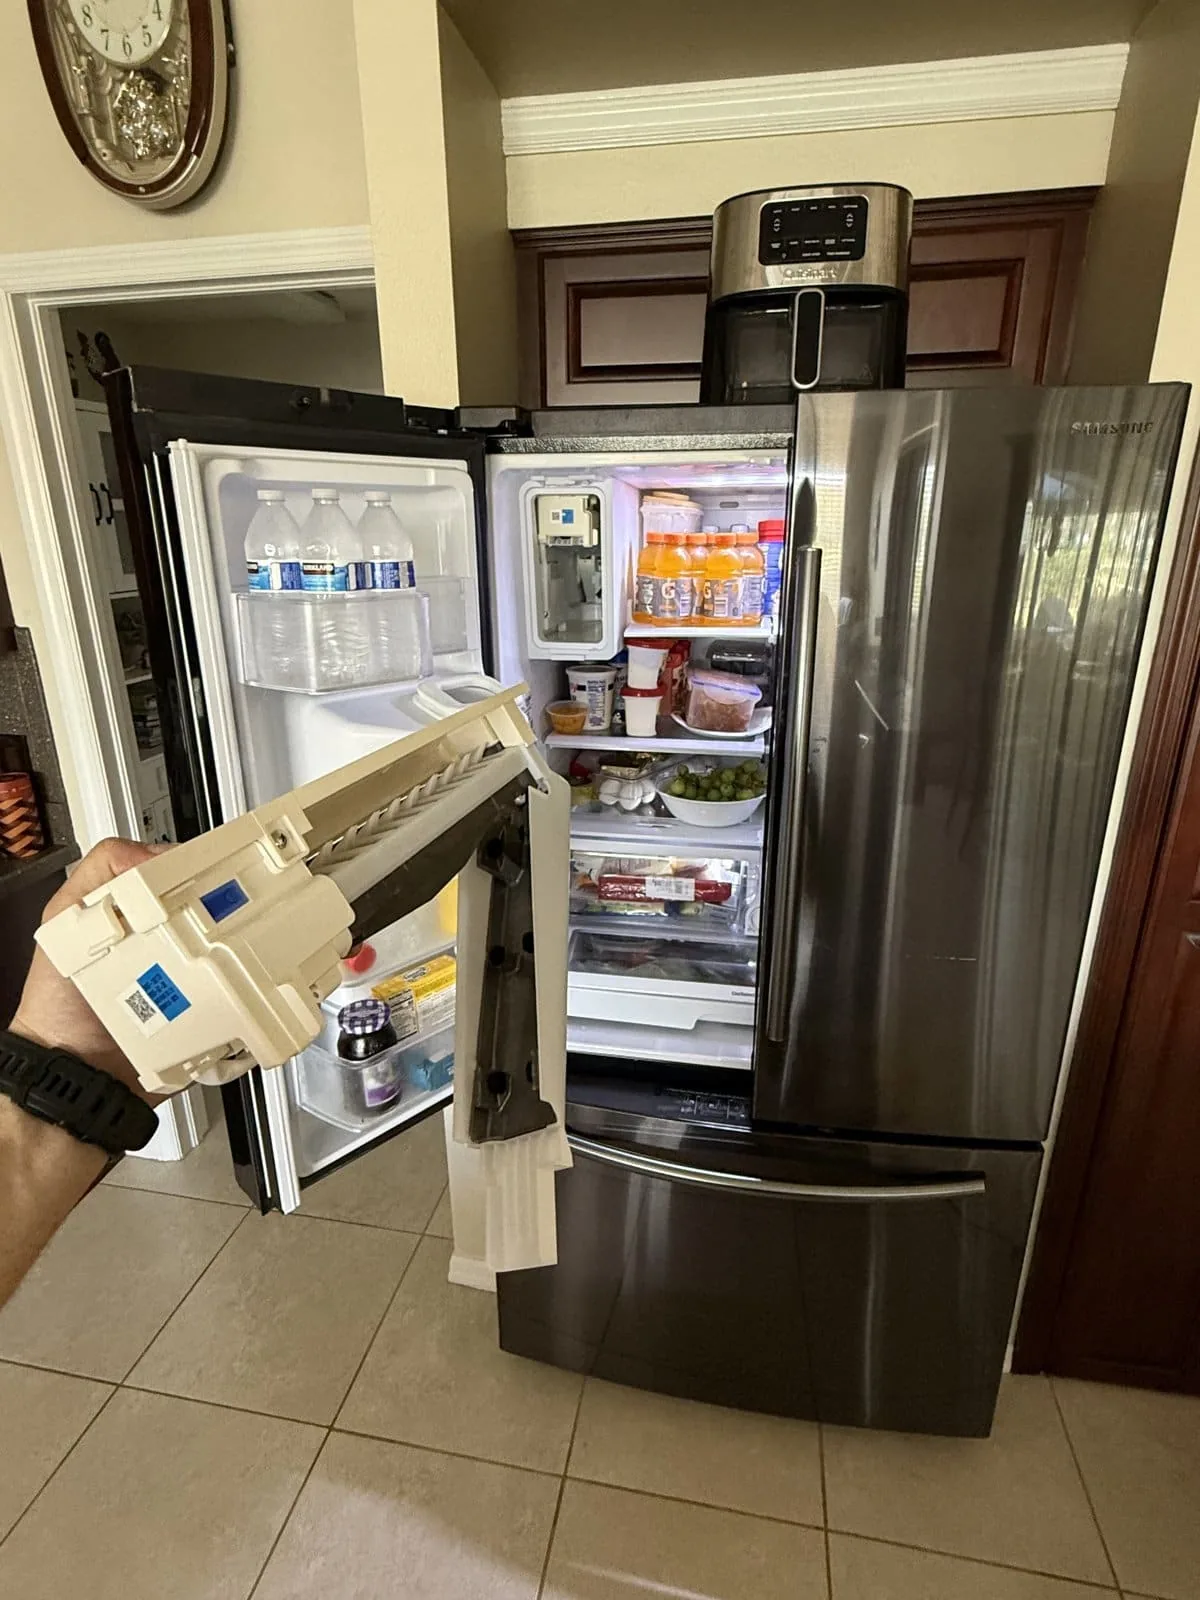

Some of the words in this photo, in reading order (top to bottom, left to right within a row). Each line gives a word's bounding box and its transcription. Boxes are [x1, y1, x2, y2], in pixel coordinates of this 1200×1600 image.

[82, 4, 93, 27] 8
[152, 0, 162, 21] 4
[101, 29, 109, 51] 7
[122, 34, 132, 57] 6
[142, 24, 152, 47] 5
[783, 266, 838, 280] Cuisinart
[1071, 420, 1153, 436] SAMSUNG
[661, 582, 676, 599] G
